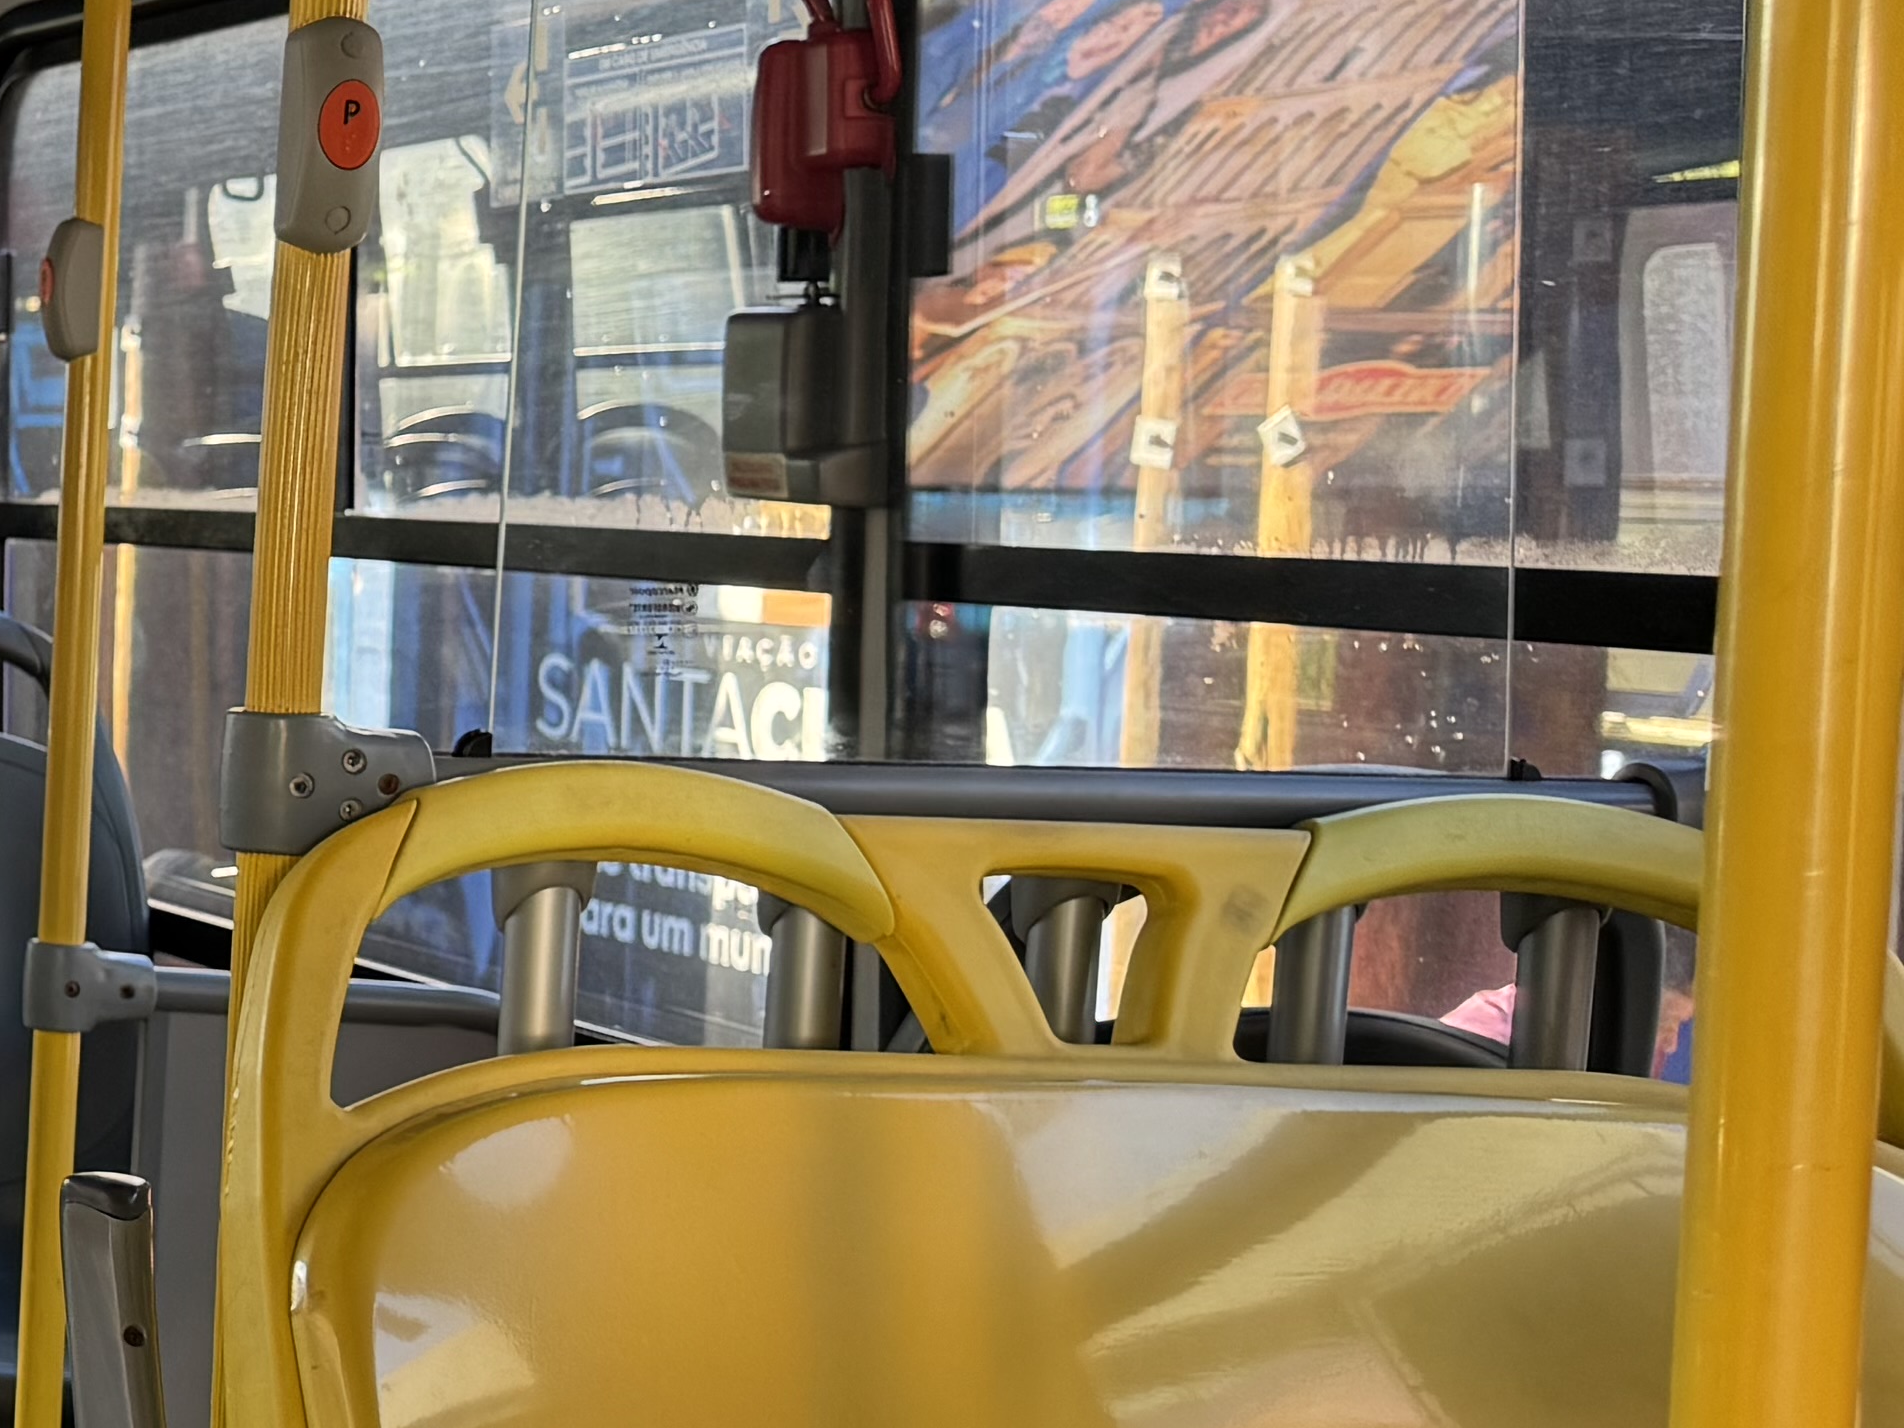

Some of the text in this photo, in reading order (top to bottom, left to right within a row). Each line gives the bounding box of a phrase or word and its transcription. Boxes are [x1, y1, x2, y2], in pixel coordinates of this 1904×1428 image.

[343, 99, 361, 125] P
[702, 633, 819, 671] VIAÇÃO
[580, 897, 773, 976] ara um mun
